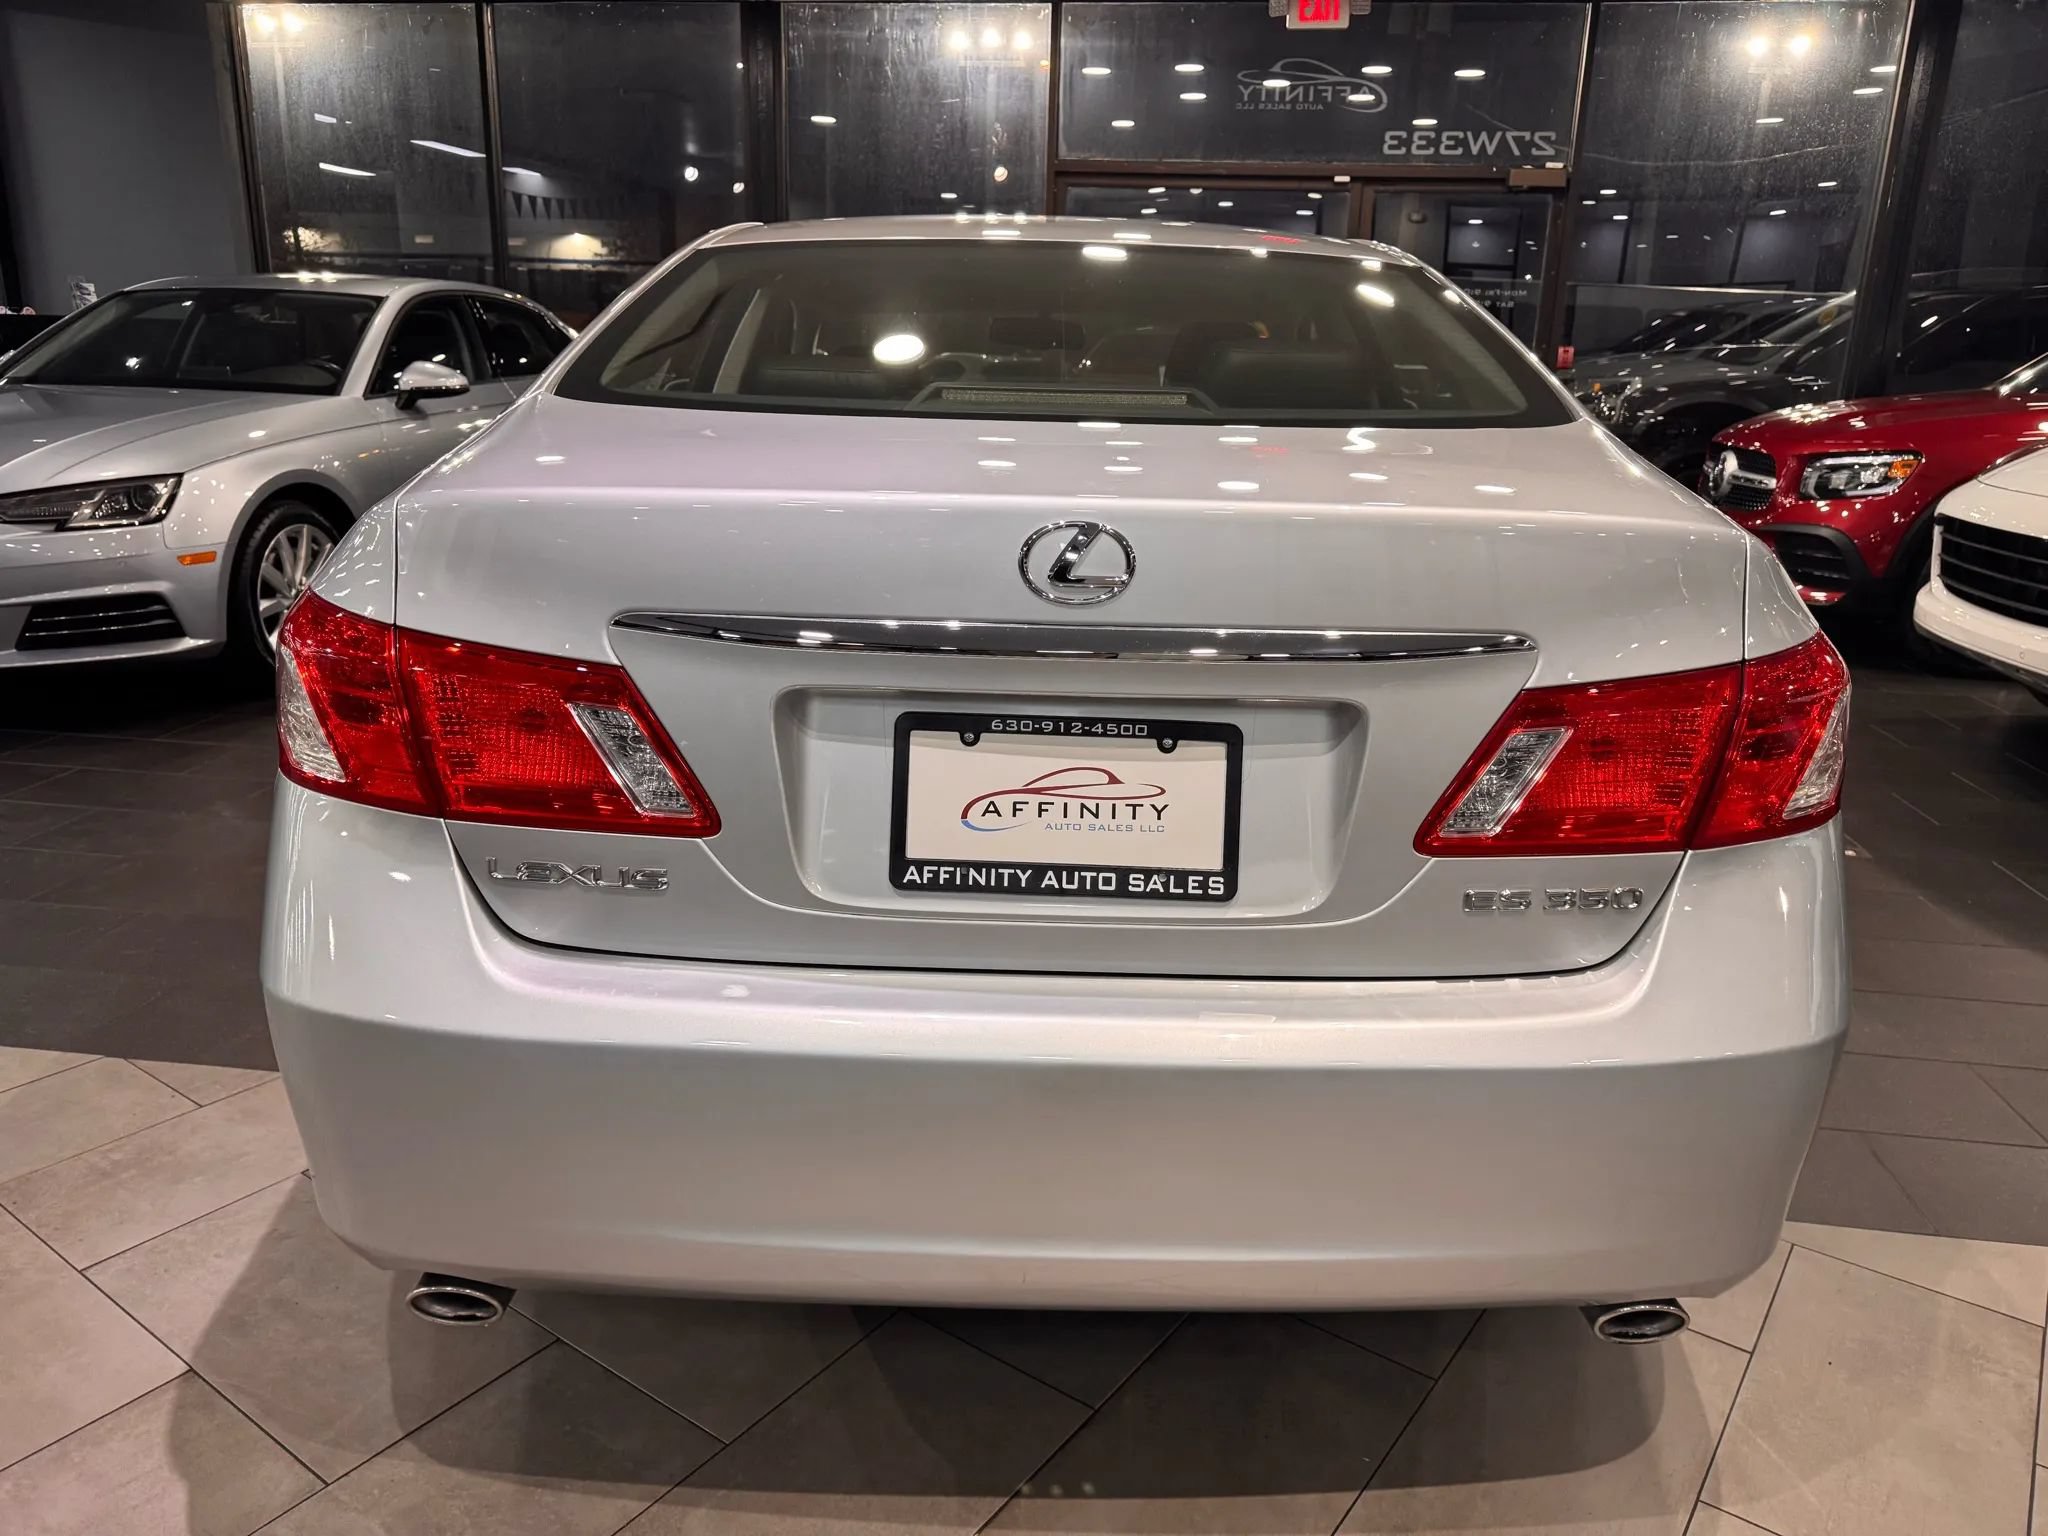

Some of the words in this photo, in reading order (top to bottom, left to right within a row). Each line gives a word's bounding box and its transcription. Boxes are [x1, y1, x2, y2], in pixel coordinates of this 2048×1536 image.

[991, 719, 1148, 736] 630-912-4500
[980, 800, 1170, 821] AFFINITY
[1044, 823, 1082, 832] AUTO
[1088, 823, 1133, 832] SALES
[1140, 824, 1165, 833] LLC
[485, 857, 669, 890] LEXUS
[903, 866, 1032, 888] AFFINITY
[1041, 871, 1116, 891] AUTO
[1128, 873, 1225, 895] SALES
[1463, 888, 1531, 912] ES
[1543, 886, 1644, 912] 350
